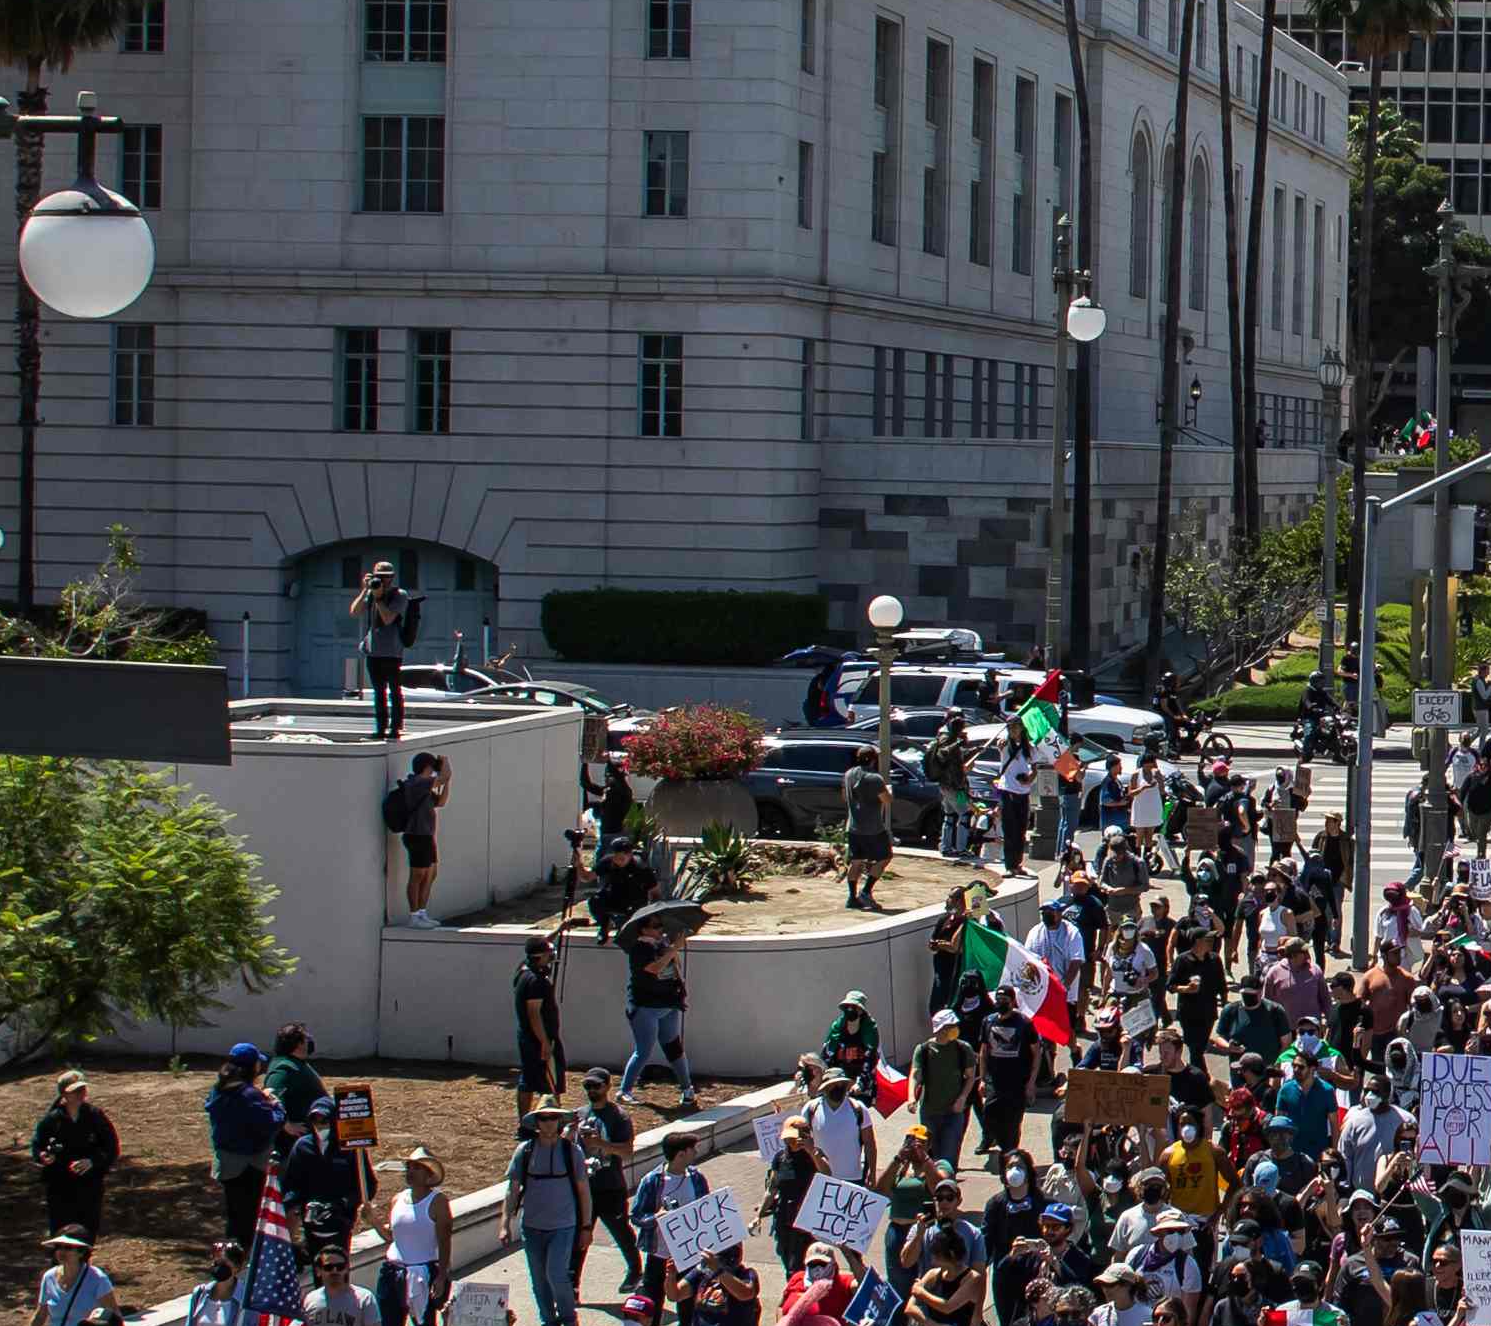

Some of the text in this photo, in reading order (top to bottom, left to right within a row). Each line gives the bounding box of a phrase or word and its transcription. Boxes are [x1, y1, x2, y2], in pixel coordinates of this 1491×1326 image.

[1418, 695, 1455, 705] EXCEPT
[1432, 1053, 1488, 1085] DUE
[1431, 1106, 1481, 1140] FOR
[1419, 1134, 1491, 1166] ALL
[663, 1187, 740, 1239] FUCK
[821, 1182, 877, 1222] FUCK
[676, 1220, 733, 1264] ICE
[810, 1214, 857, 1245] ICE
